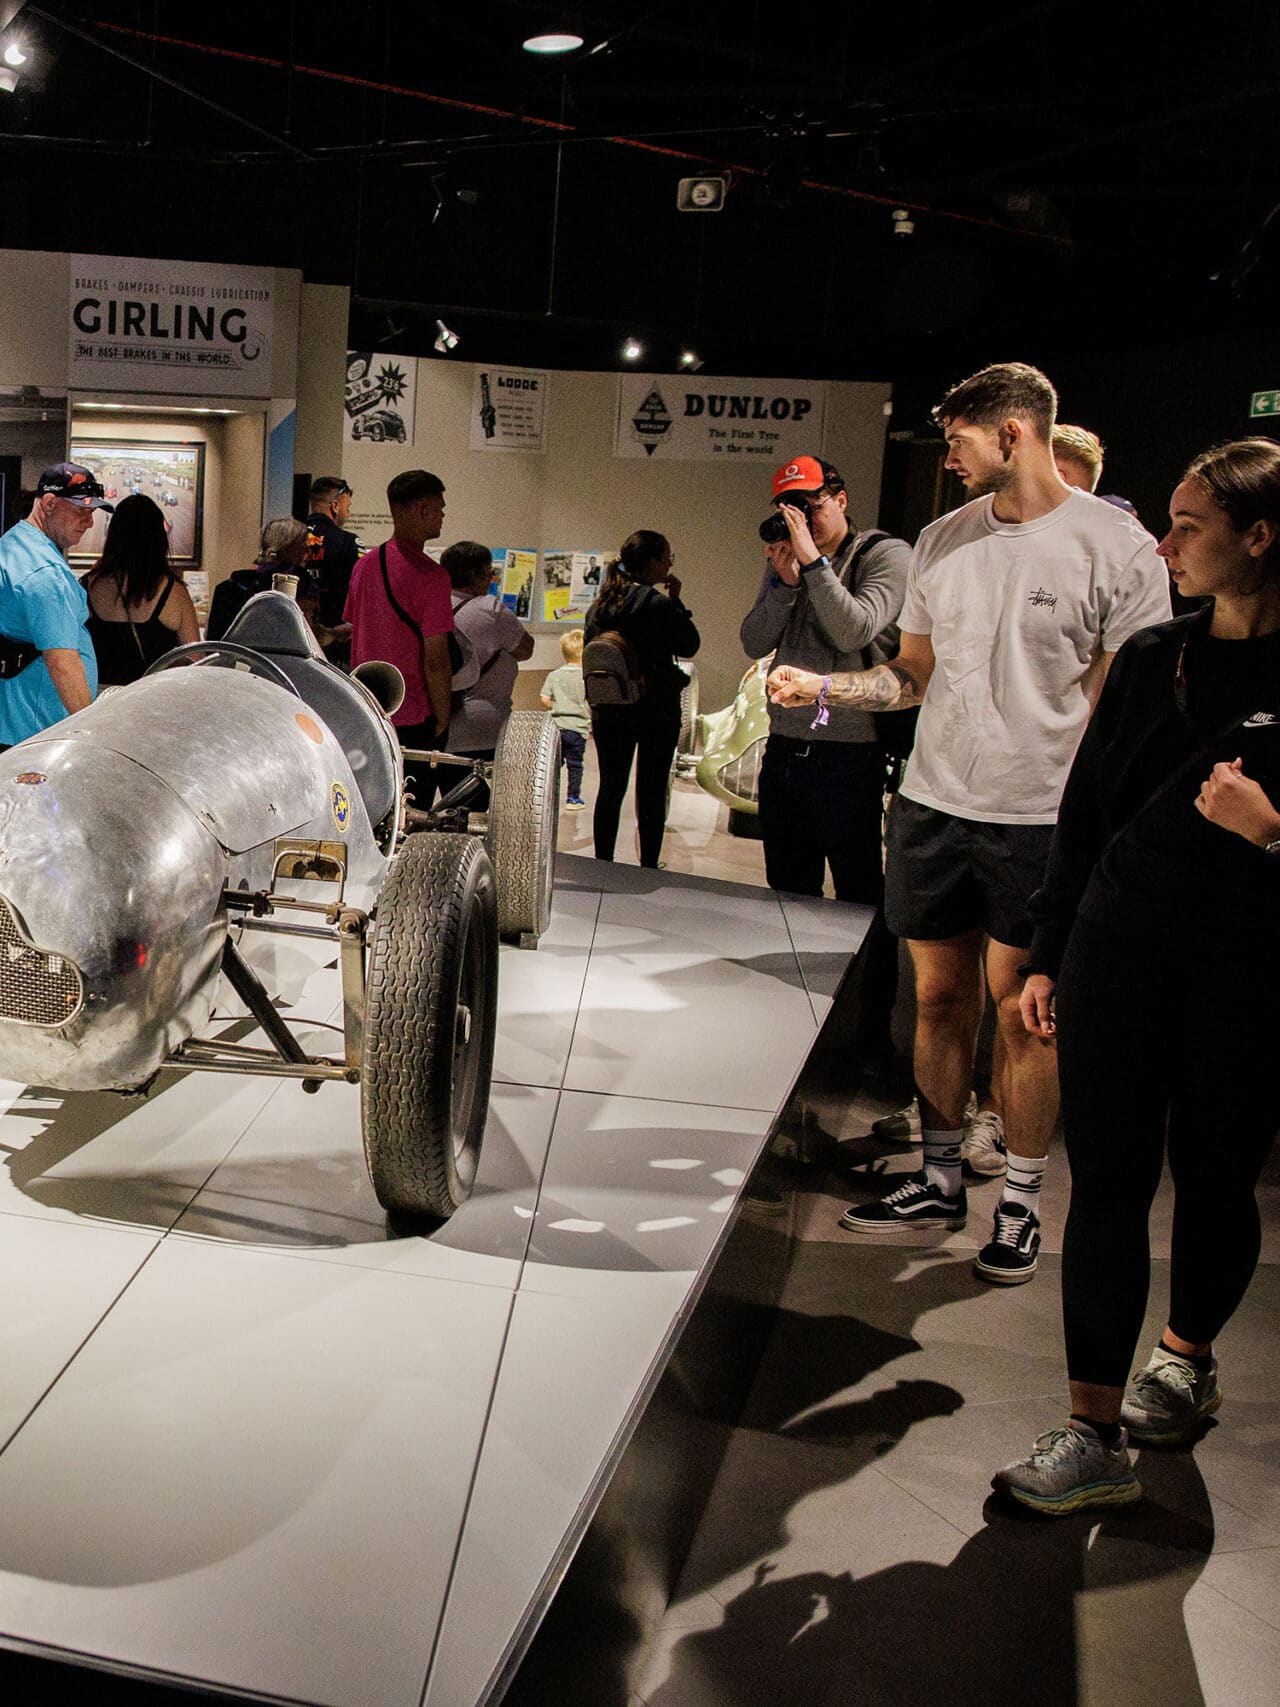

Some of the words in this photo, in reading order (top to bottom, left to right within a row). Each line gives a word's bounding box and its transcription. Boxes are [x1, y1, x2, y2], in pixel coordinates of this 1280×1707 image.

[75, 278, 109, 291] BRAKES
[169, 282, 205, 297] CHASSIS
[211, 287, 270, 301] LUBRICATION
[73, 298, 247, 343] GIRLING
[79, 344, 93, 356] THE
[98, 346, 118, 358] BEST
[123, 348, 157, 360] BRAKES
[175, 351, 191, 363] THE
[684, 393, 811, 421] DUNLOP
[709, 428, 727, 438] The
[732, 429, 754, 440] First
[760, 430, 780, 441] Tyre
[727, 444, 742, 453] the
[1249, 712, 1275, 722] NIKE
